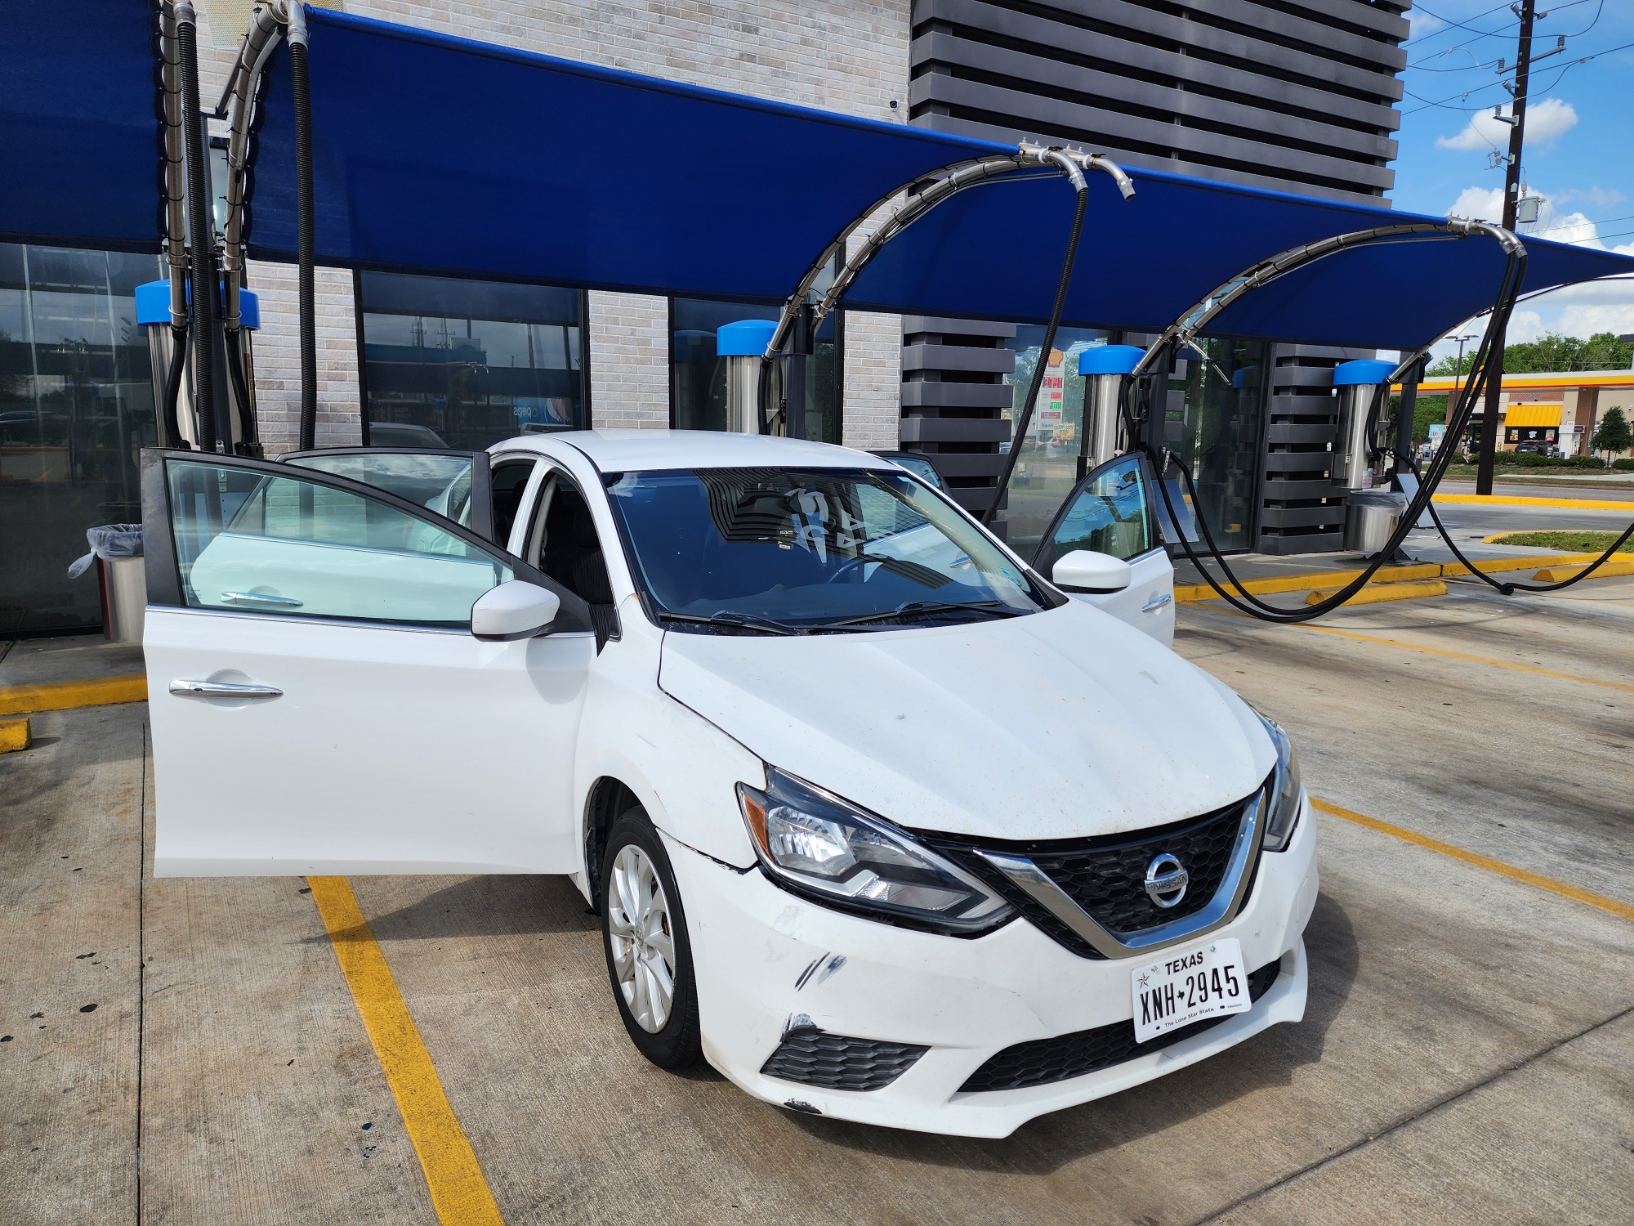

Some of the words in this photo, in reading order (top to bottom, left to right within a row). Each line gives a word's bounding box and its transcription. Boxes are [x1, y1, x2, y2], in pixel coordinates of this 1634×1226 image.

[1164, 951, 1204, 976] TEXAS
[1175, 1016, 1187, 1024] Lone
[1187, 1011, 1198, 1019] Star
[1198, 1007, 1214, 1015] State
